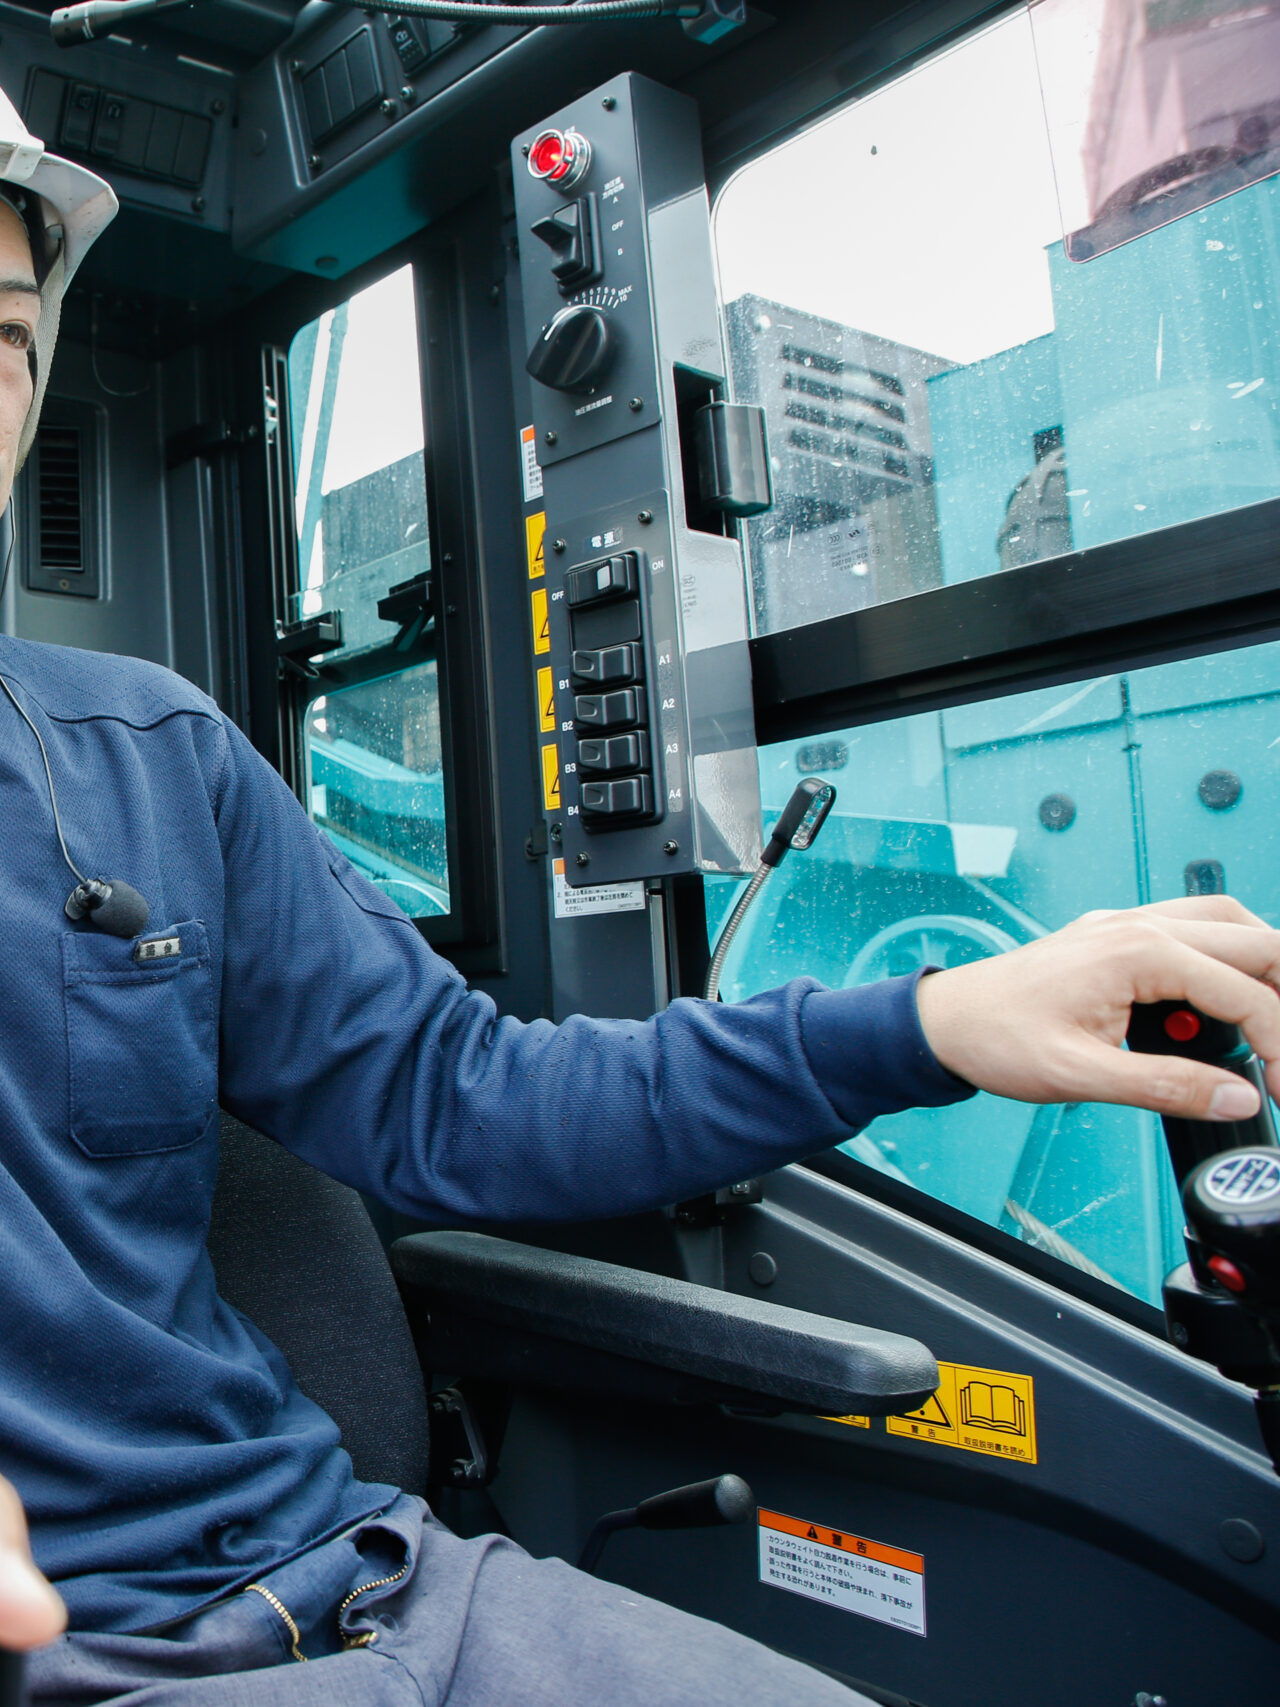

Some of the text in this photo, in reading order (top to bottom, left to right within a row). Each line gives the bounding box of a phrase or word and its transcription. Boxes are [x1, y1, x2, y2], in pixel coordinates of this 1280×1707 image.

[611, 219, 624, 231] OFF
[618, 285, 632, 297] MAX
[591, 531, 615, 548] 電源
[651, 560, 665, 571] ON
[552, 591, 564, 601] OFF
[658, 655, 671, 665] A1
[558, 679, 570, 690] B1
[662, 698, 675, 709] A2
[562, 721, 574, 731] B2
[665, 743, 679, 755] A3
[565, 763, 577, 774] B3
[668, 788, 682, 800] A4
[567, 805, 579, 816] B4
[911, 1424, 936, 1439] 警告
[831, 1533, 867, 1554] 警告
